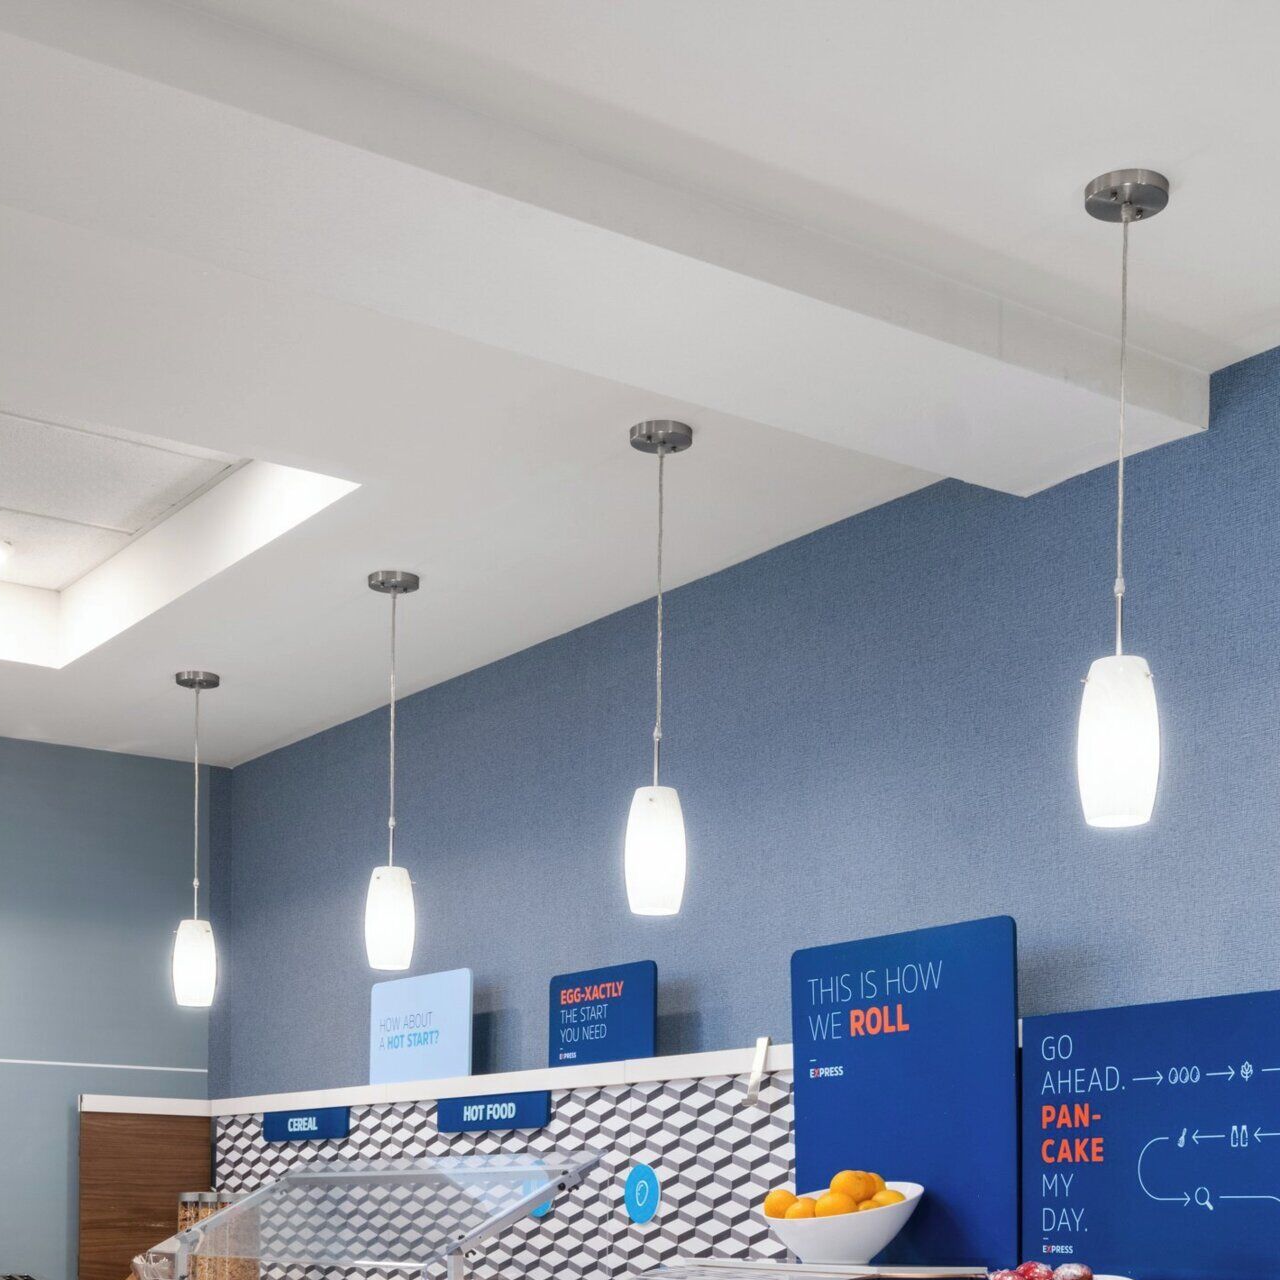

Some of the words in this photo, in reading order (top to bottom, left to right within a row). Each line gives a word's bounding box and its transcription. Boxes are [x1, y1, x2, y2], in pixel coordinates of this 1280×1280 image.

[561, 981, 624, 1005] EGG-XACTLY
[808, 973, 852, 1006] THIS
[860, 970, 877, 999] IS
[886, 960, 942, 996] HOW
[380, 1016, 400, 1032] HOW
[403, 1011, 432, 1030] ABOUT
[560, 1008, 578, 1024] THE
[581, 1004, 608, 1022] START
[809, 1012, 842, 1041] WE
[850, 1004, 910, 1037] ROLL
[380, 1036, 385, 1050] A
[388, 1034, 405, 1049] HOT
[407, 1030, 439, 1047] START?
[560, 1027, 579, 1043] YOU
[582, 1024, 607, 1040] NEED
[1041, 1035, 1073, 1061] GO
[810, 1066, 844, 1078] EXPRESS
[1041, 1066, 1126, 1095] AHEAD.
[463, 1104, 485, 1121] HOT
[486, 1102, 516, 1120] FOOD
[1041, 1103, 1101, 1129] PAN-
[288, 1117, 318, 1132] CEREAL
[1041, 1137, 1104, 1163] CAKE
[1042, 1173, 1074, 1198] MY
[1042, 1207, 1088, 1232] DAY.
[1042, 1245, 1073, 1254] EXPRESS
